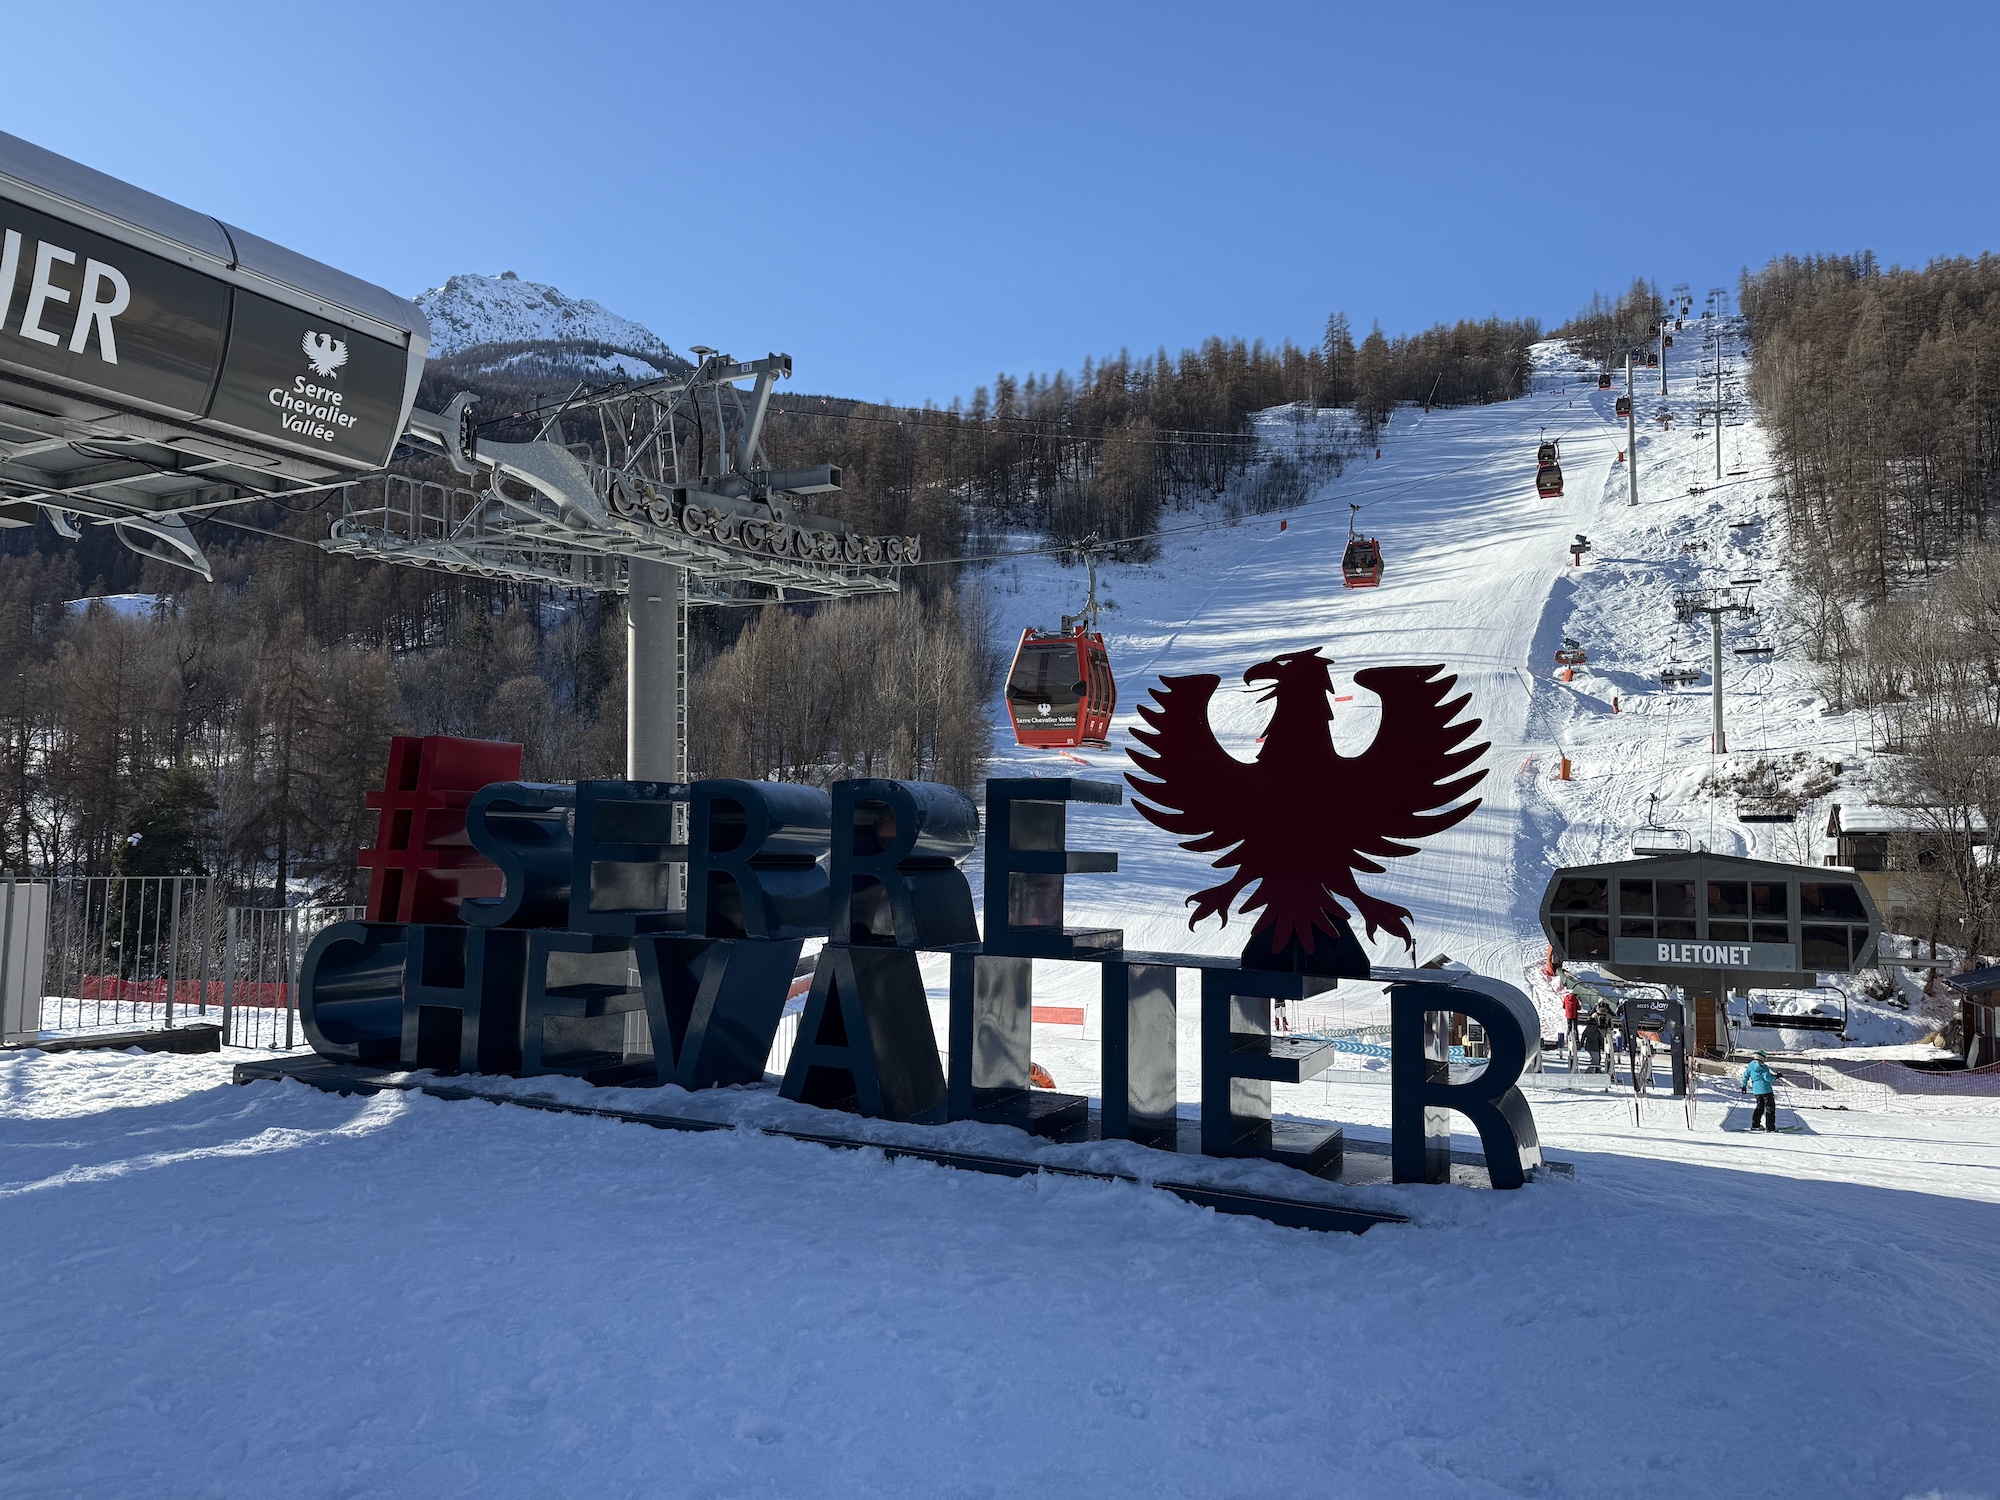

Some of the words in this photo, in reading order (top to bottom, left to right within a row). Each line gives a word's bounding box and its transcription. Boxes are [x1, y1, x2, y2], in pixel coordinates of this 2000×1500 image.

[293, 375, 343, 406] Serre
[268, 388, 358, 429] Chevalier
[282, 412, 335, 442] Vallée
[1031, 716, 1058, 724] Chevalier
[357, 735, 1121, 957] #SERRE
[1657, 943, 1752, 966] BLETONET
[300, 920, 1541, 1190] CHEVALIER
